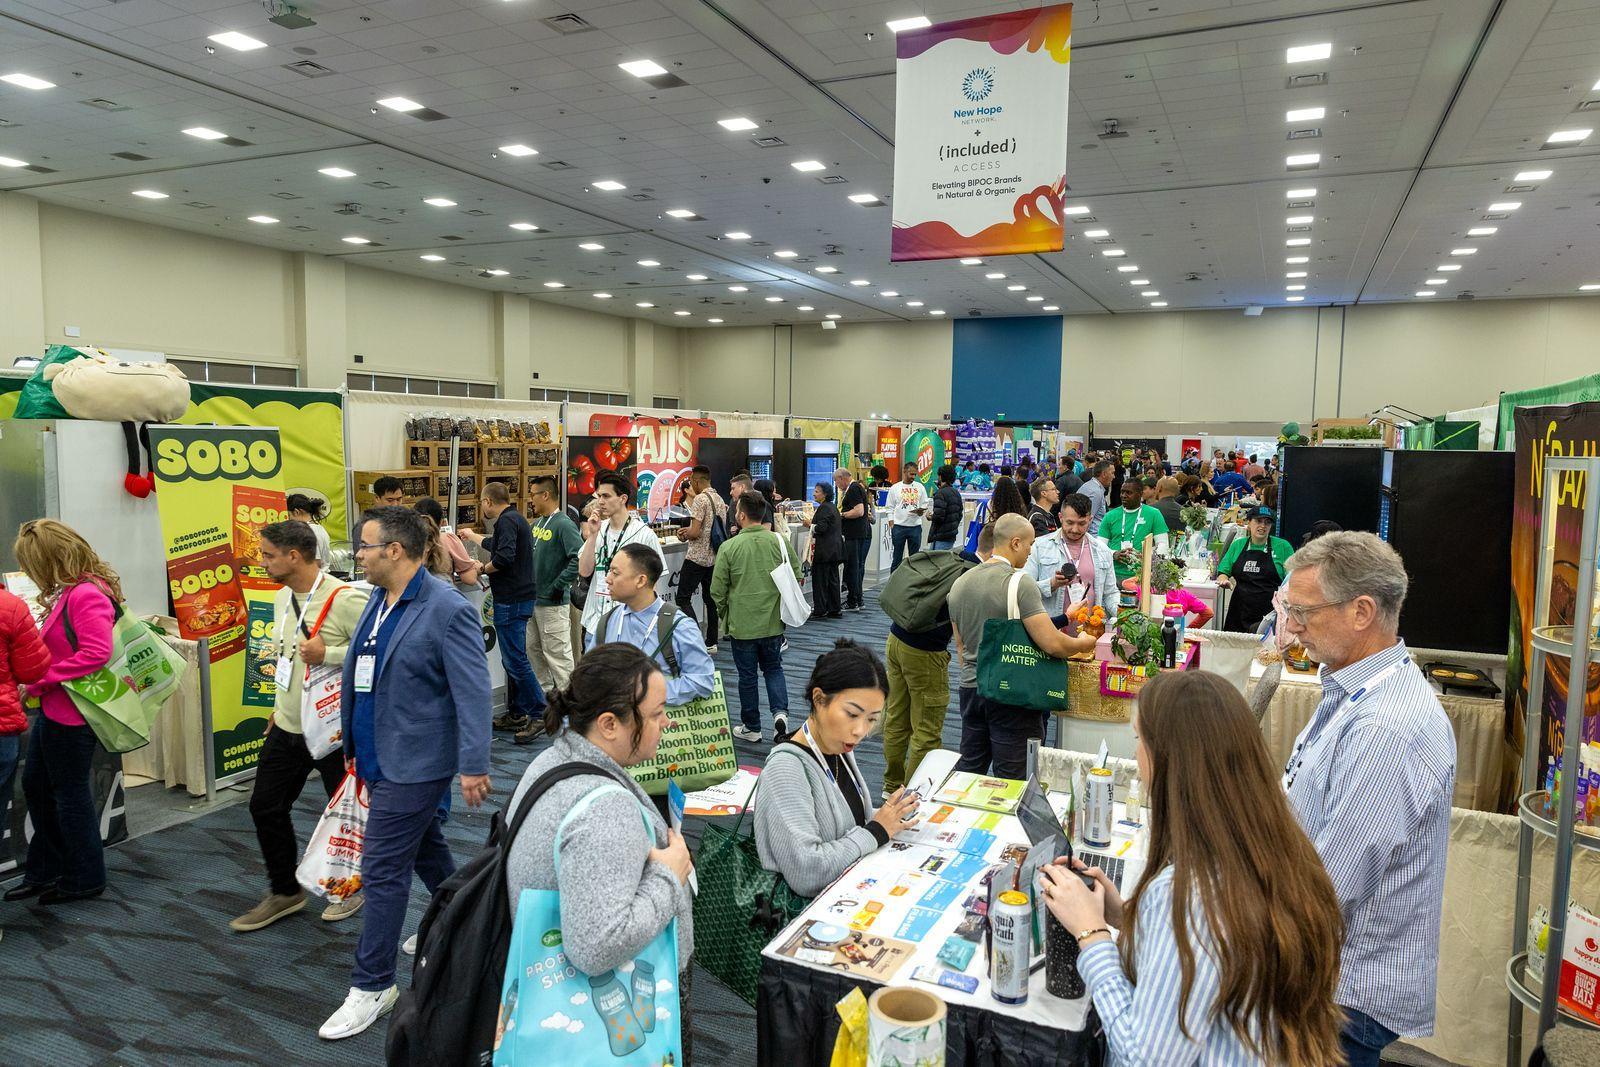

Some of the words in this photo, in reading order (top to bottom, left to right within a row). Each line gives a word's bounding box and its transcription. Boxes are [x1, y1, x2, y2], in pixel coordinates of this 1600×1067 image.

[954, 109, 975, 119] New
[977, 105, 1002, 116] Hope
[954, 161, 1000, 172] ACCESS
[932, 181, 966, 191] Elevating
[967, 178, 992, 187] BIPOC
[994, 175, 1022, 185] Brands
[945, 188, 974, 198] Natural
[976, 188, 982, 196] &
[984, 186, 1015, 196] Organic
[157, 438, 278, 476] SOBO
[169, 533, 228, 554] SOBOFOODS.COM
[174, 526, 219, 544] @SOBOFOODS
[170, 564, 233, 600] SOBO
[1001, 654, 1036, 666] MATTER
[1002, 644, 1050, 660] INGREDENTS
[687, 703, 726, 717] Bloom
[689, 717, 728, 731] Bloom
[692, 731, 730, 746] Bloom
[224, 758, 243, 770] FOR
[244, 752, 260, 764] OU
[655, 752, 694, 765] Bloom
[695, 746, 733, 760] Bloom
[657, 766, 697, 780] Bloom
[698, 760, 736, 774] Bloom
[326, 846, 360, 861] GUMMY
[1574, 946, 1593, 961] happy
[526, 952, 566, 978] PROB
[542, 966, 576, 989] SHO
[1575, 975, 1597, 994] QUICK
[1573, 986, 1594, 1005] OATS
